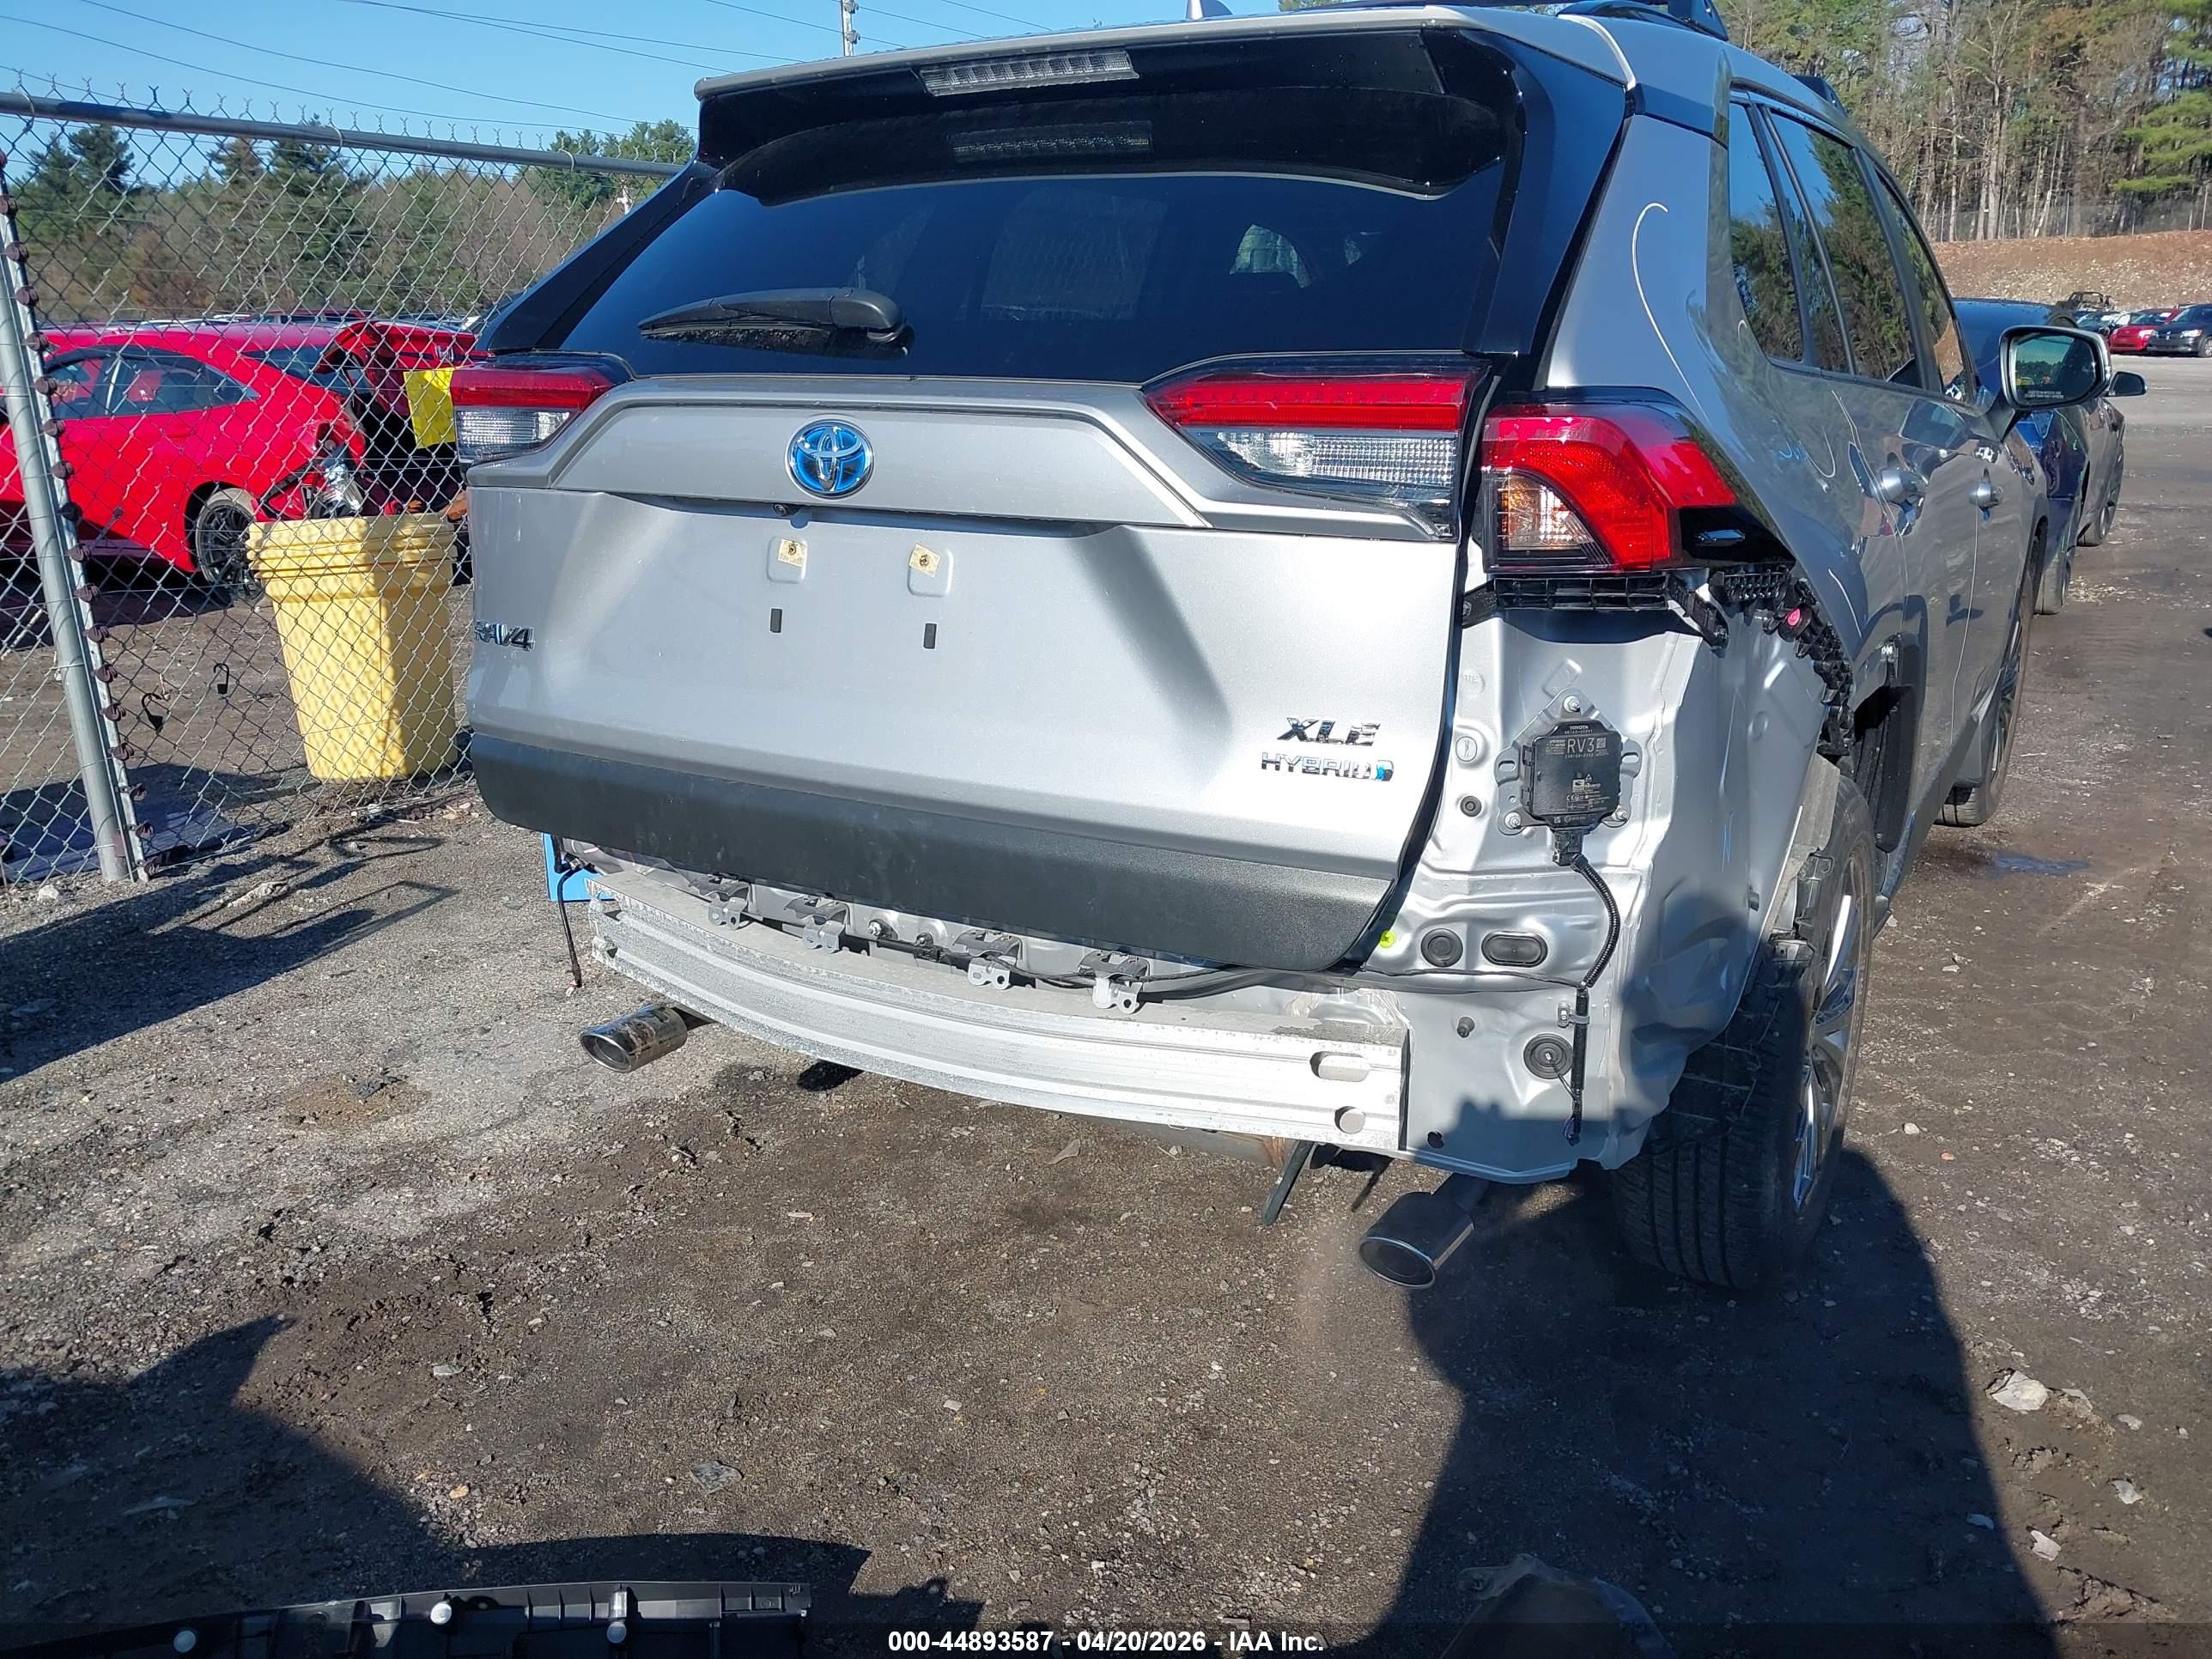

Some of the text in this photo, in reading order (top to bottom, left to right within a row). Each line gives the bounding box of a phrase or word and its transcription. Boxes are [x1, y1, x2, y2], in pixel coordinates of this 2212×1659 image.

[1276, 716, 1381, 746] XLE
[1566, 737, 1595, 754] RV3
[1261, 751, 1374, 780] HYBRID
